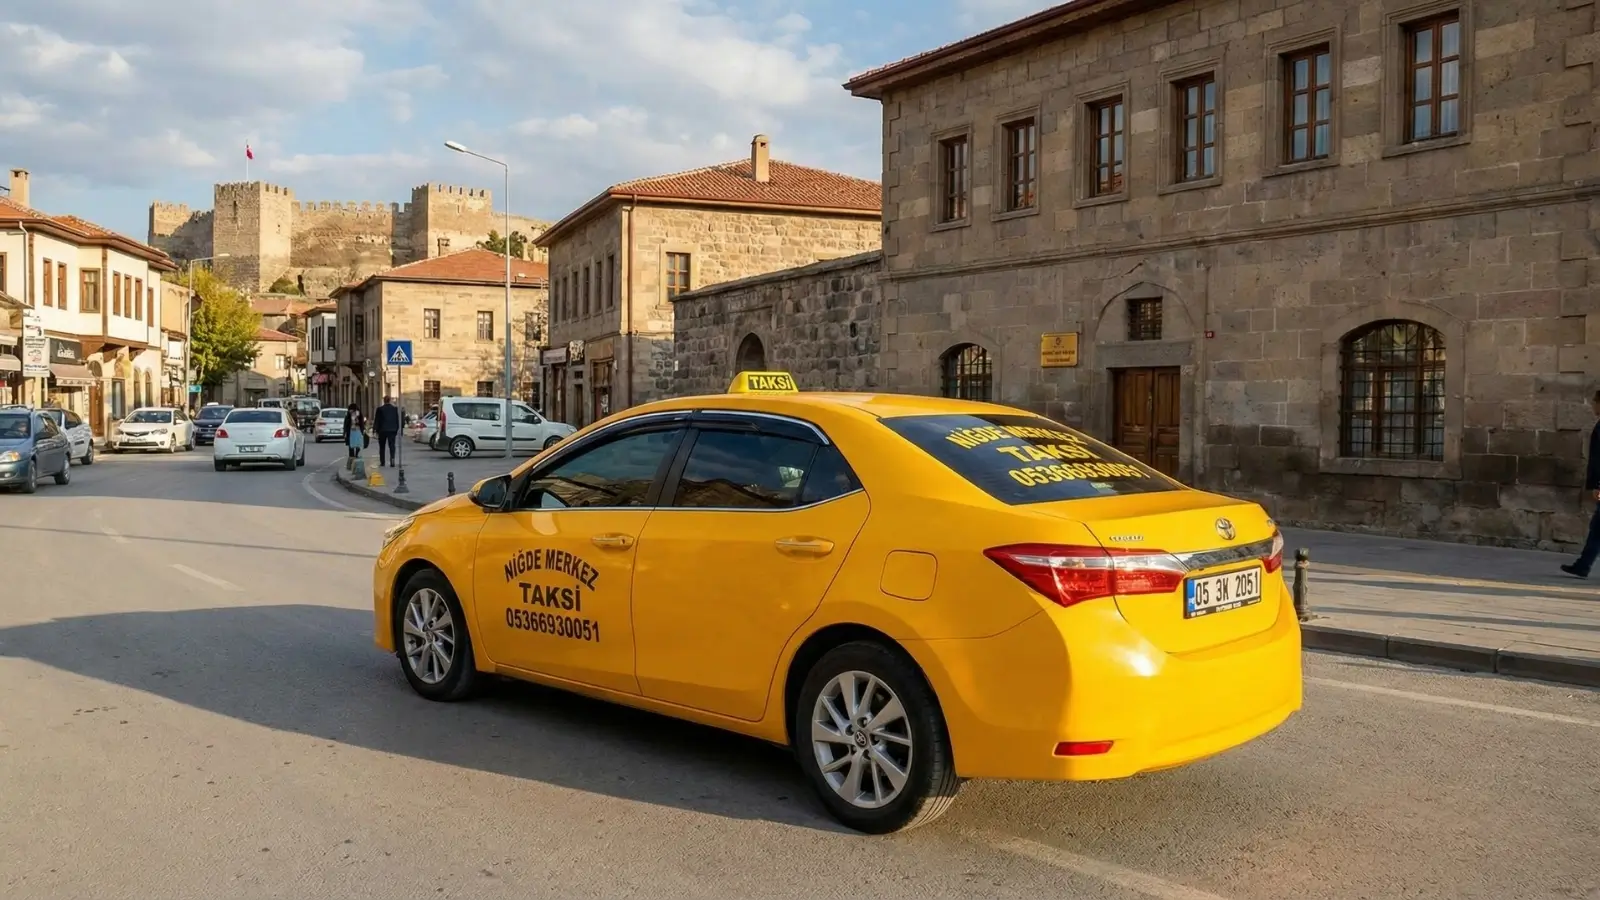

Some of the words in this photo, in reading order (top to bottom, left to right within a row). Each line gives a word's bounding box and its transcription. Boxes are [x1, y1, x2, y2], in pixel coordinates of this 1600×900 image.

[749, 375, 791, 389] TAKSİ
[504, 548, 541, 582] NİĞDE
[545, 548, 599, 592] MERKEZ
[519, 582, 581, 612] TAKSİ
[1195, 581, 1209, 606] 05
[1216, 578, 1229, 602] 3K
[1235, 571, 1259, 598] 2051
[506, 607, 600, 643] 05366930051
